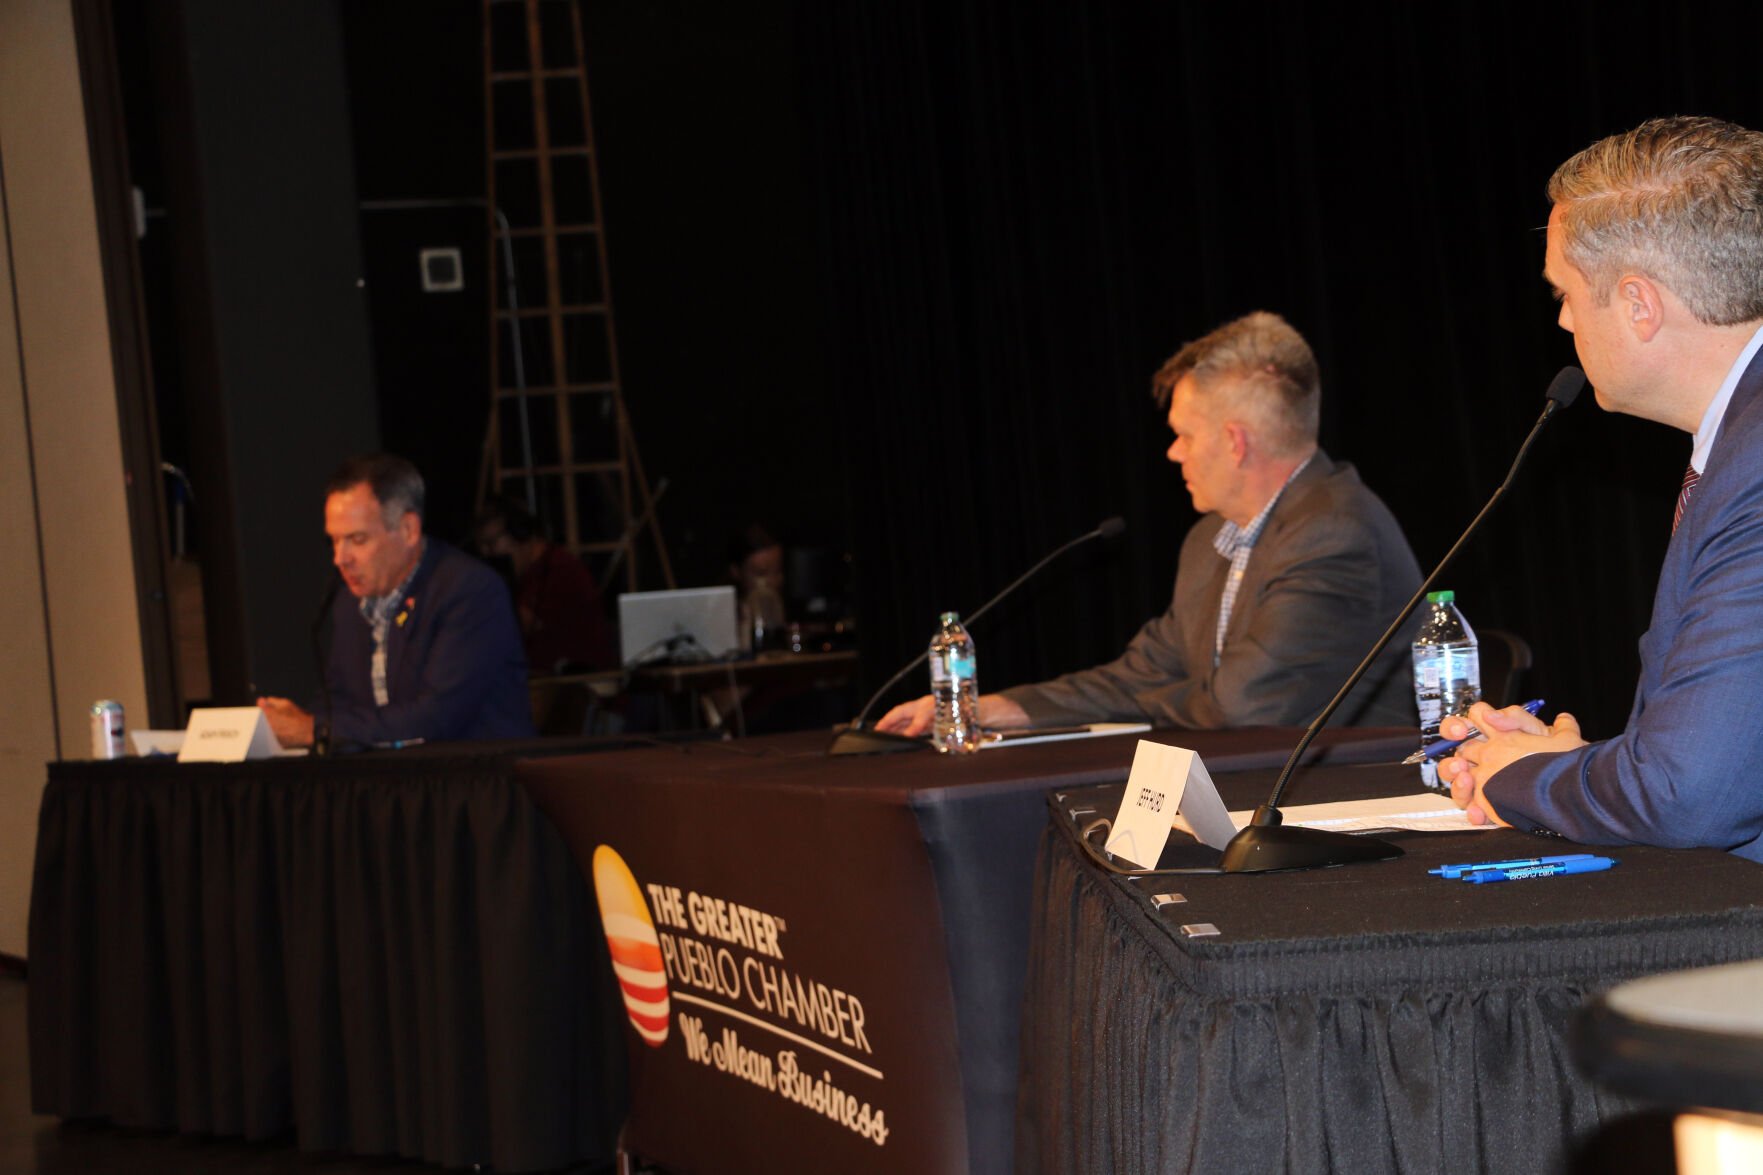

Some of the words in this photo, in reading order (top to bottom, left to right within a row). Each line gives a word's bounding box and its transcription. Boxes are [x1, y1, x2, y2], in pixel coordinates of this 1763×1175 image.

[647, 883, 688, 929] THE
[688, 891, 783, 960] GREATER
[659, 933, 741, 1000] PUEBLO
[743, 957, 873, 1054] CHAMBER
[678, 1012, 712, 1066] We
[712, 1027, 777, 1092] Mean
[777, 1050, 889, 1146] Business
